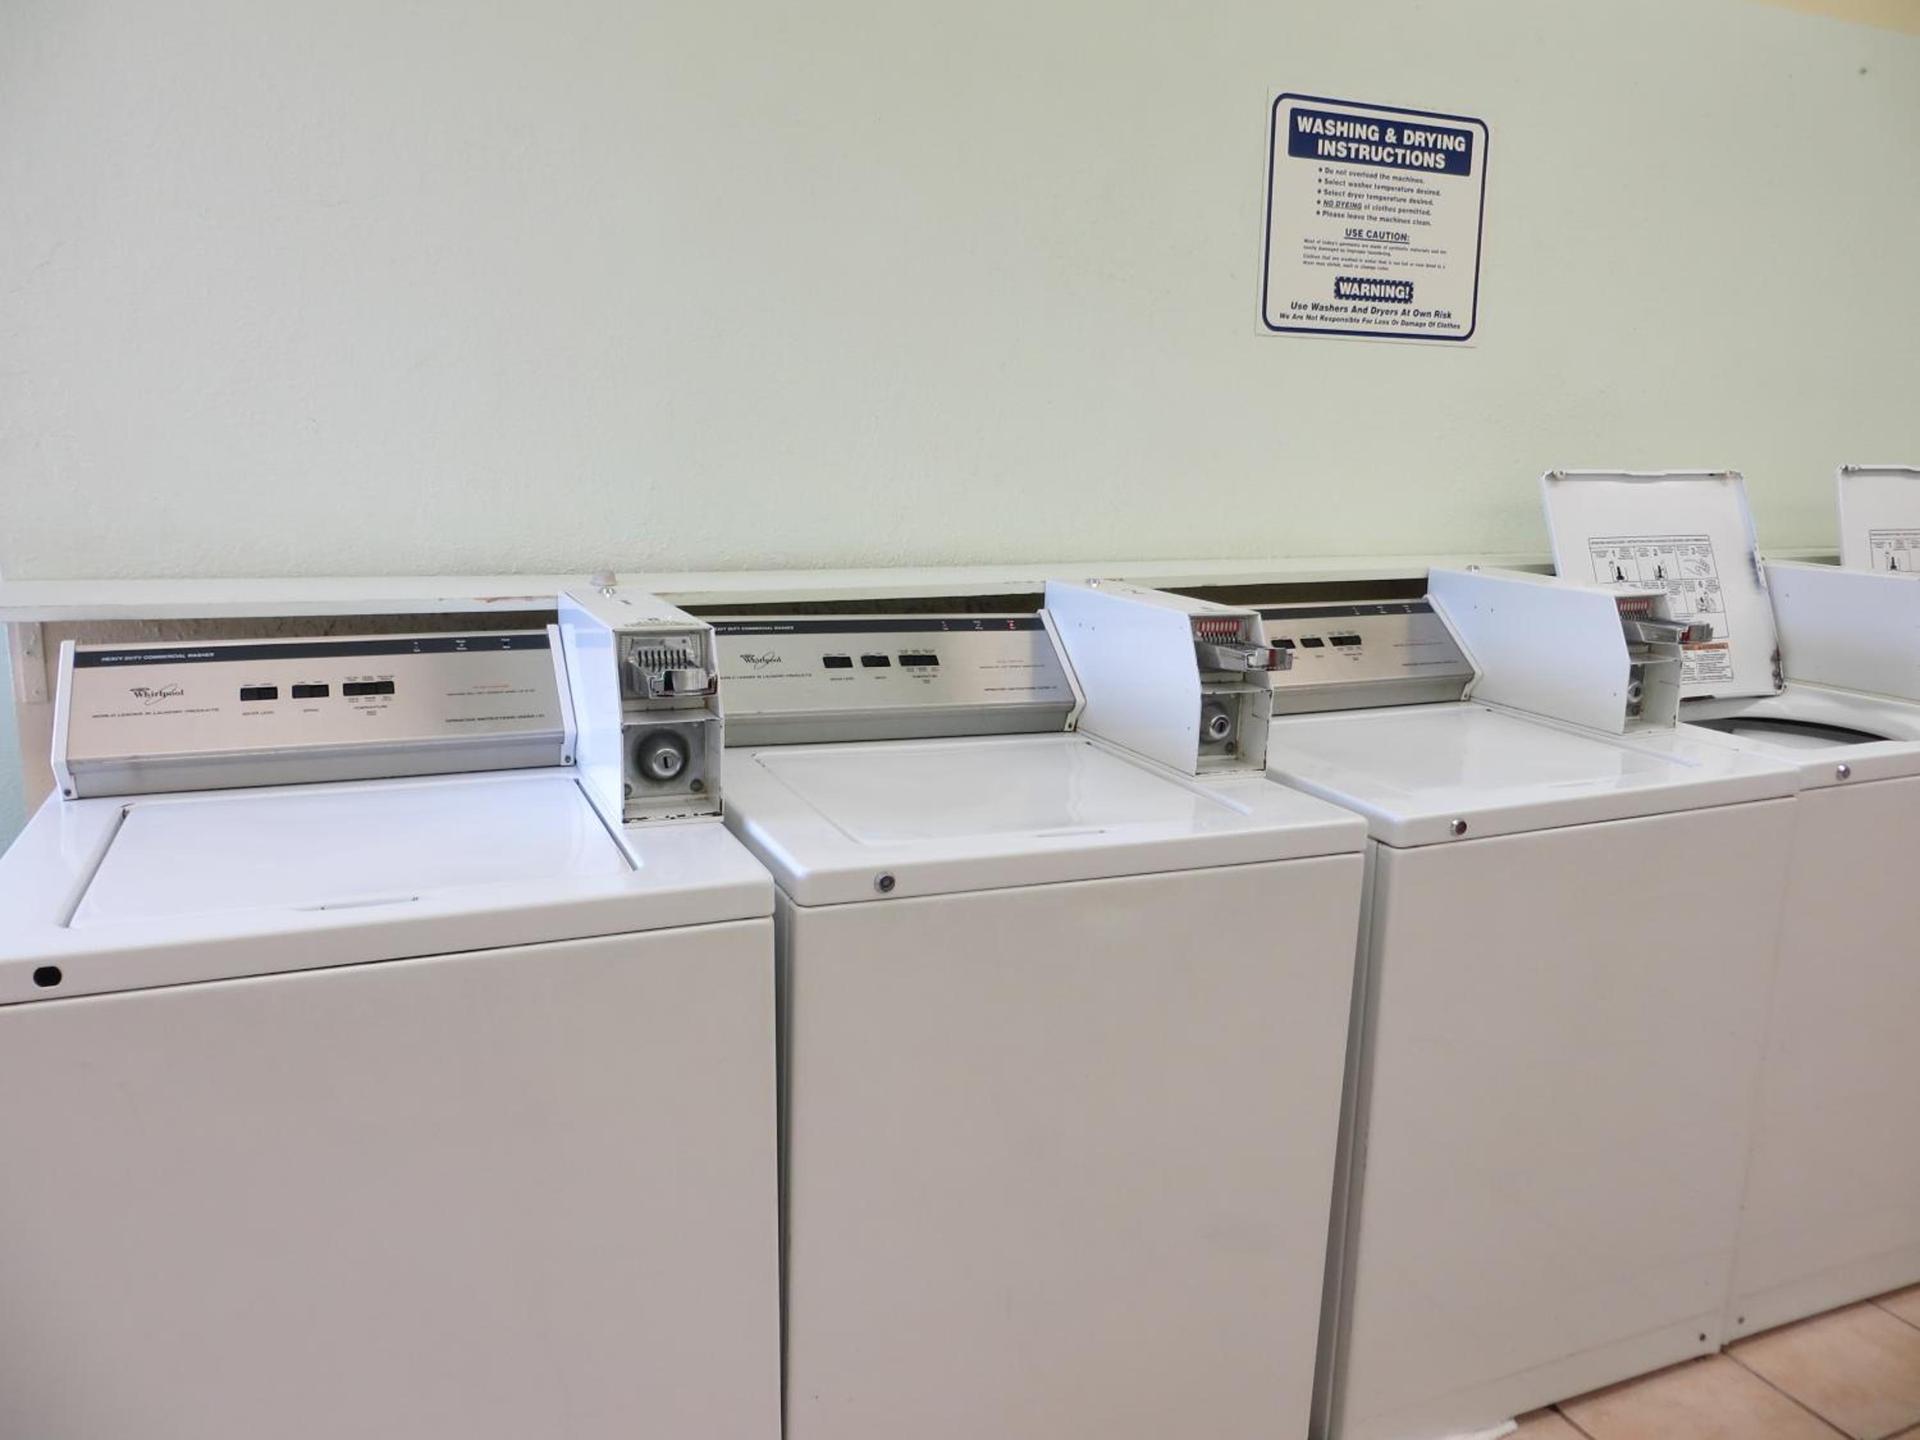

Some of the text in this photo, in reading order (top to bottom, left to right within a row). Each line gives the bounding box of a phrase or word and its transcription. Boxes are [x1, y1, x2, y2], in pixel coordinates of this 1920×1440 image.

[1297, 116, 1466, 152] WASHING & DRYING
[1317, 139, 1445, 169] INSTRUCTIONS
[1336, 168, 1346, 176] not
[1348, 169, 1377, 180] overload
[1379, 172, 1390, 181] the
[1392, 175, 1423, 184] machines.
[1324, 178, 1346, 186] Select
[1348, 180, 1372, 189] washer
[1374, 183, 1414, 194] temperature
[1323, 188, 1345, 198] Select
[1347, 191, 1364, 201] dryer
[1366, 193, 1406, 205] temperature
[1323, 200, 1334, 208] NO
[1336, 201, 1362, 210] DYEING
[1372, 203, 1394, 213] clothes
[1322, 210, 1345, 221] Please
[1346, 213, 1364, 221] leave
[1366, 214, 1378, 222] the
[1379, 216, 1411, 225] machines
[1345, 229, 1410, 242] USE CAUTION:
[1339, 282, 1411, 299] WARNING!
[1290, 301, 1452, 319] Use Washers And Dryers At Own Risk
[1279, 312, 1461, 330] We Are Not Responsible For Loss Or Damage Of Clothes
[740, 654, 782, 665] Whirlpool
[129, 687, 184, 699] Whirlpool
